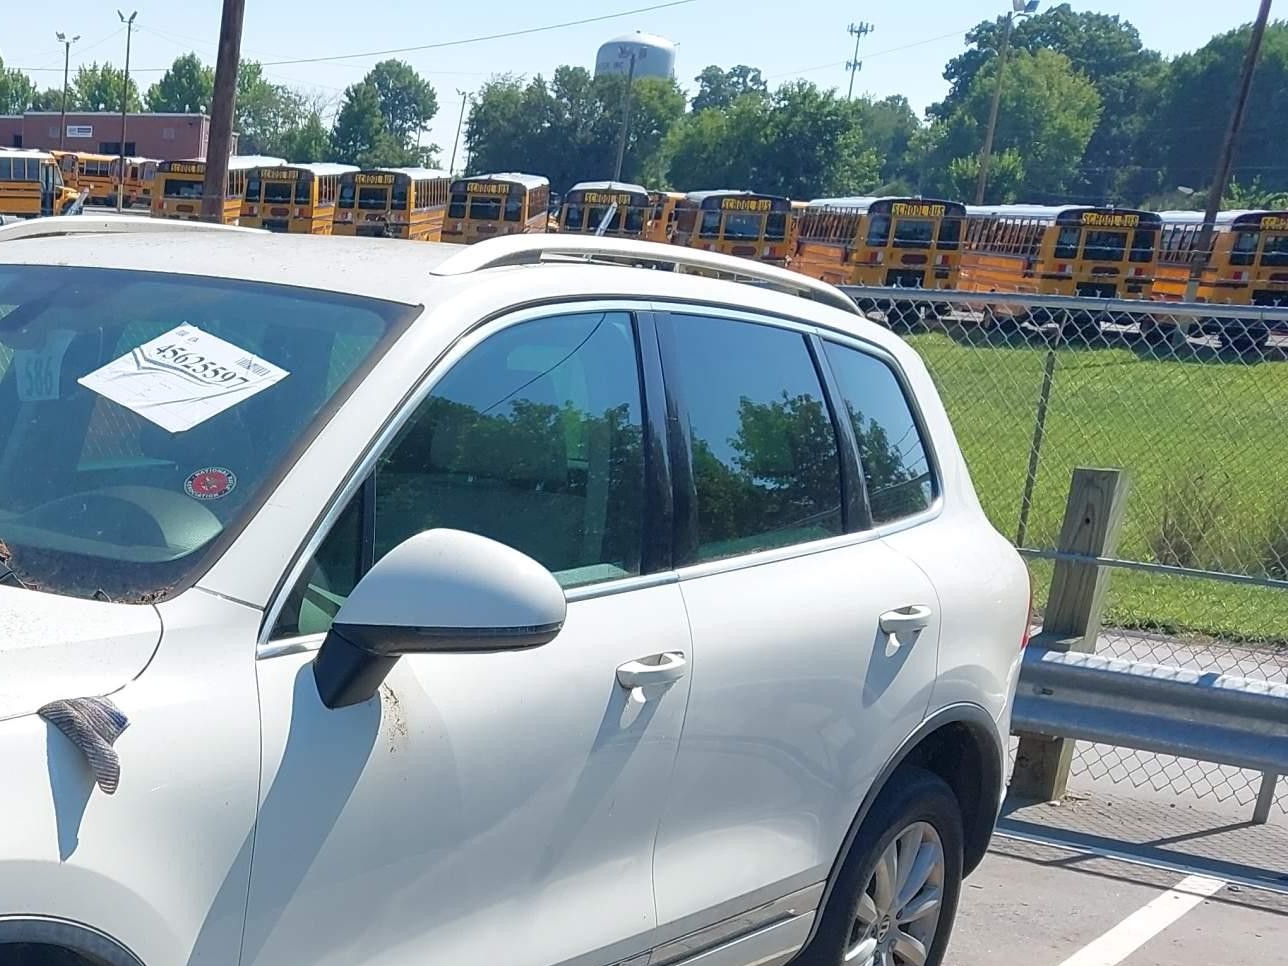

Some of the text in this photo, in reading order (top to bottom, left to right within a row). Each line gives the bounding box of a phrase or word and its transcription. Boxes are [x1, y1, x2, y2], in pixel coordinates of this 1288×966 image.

[722, 199, 750, 210] SCHOOL
[893, 203, 944, 216] SCHOOL BUS
[1082, 213, 1138, 226] SCHOOL BUS
[156, 344, 249, 388] 45625597
